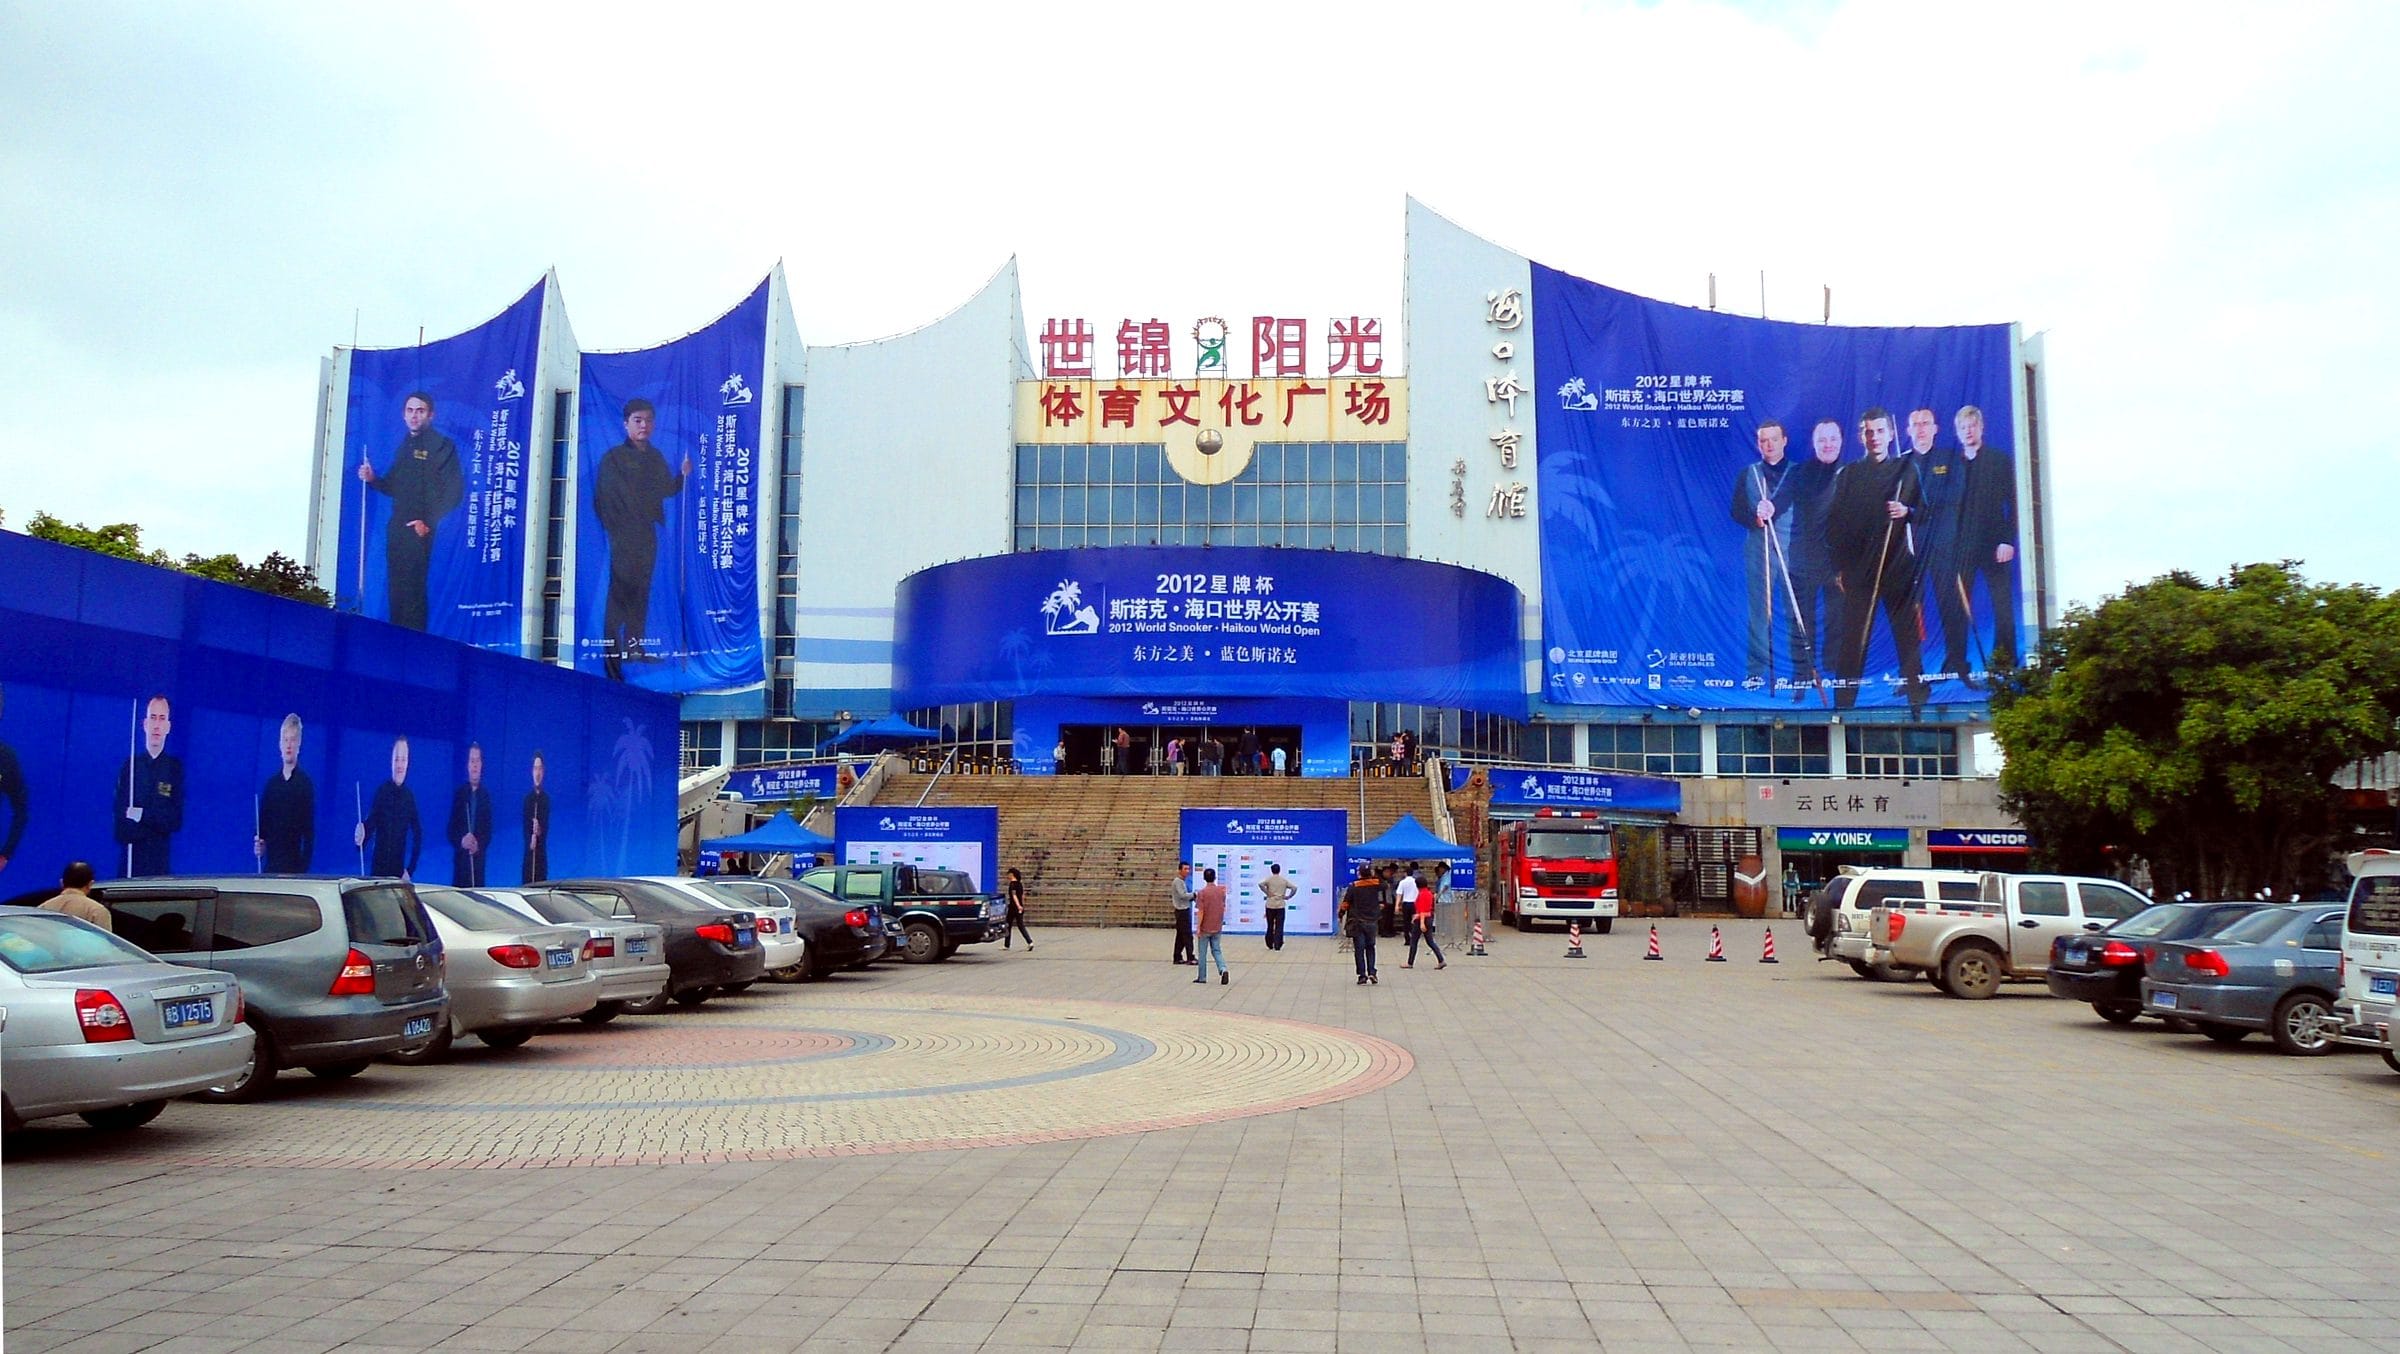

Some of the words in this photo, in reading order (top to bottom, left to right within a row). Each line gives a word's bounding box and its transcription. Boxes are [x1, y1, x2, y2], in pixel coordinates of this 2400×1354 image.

[1636, 375, 1712, 388] 2012星牌杯
[1040, 382, 1390, 428] 体育文化广场
[1726, 404, 1745, 412] Open
[1156, 574, 1274, 595] 2012星牌杯
[1109, 622, 1132, 633] 2012
[1135, 622, 1166, 632] World
[1169, 622, 1212, 632] Snooker
[1222, 623, 1257, 634] Haikou
[1260, 624, 1291, 634] World
[1294, 625, 1320, 636] Open
[1796, 795, 1890, 812] 云氏体育
[1833, 832, 1873, 846] YONEX
[1976, 834, 2028, 844] VICTOR
